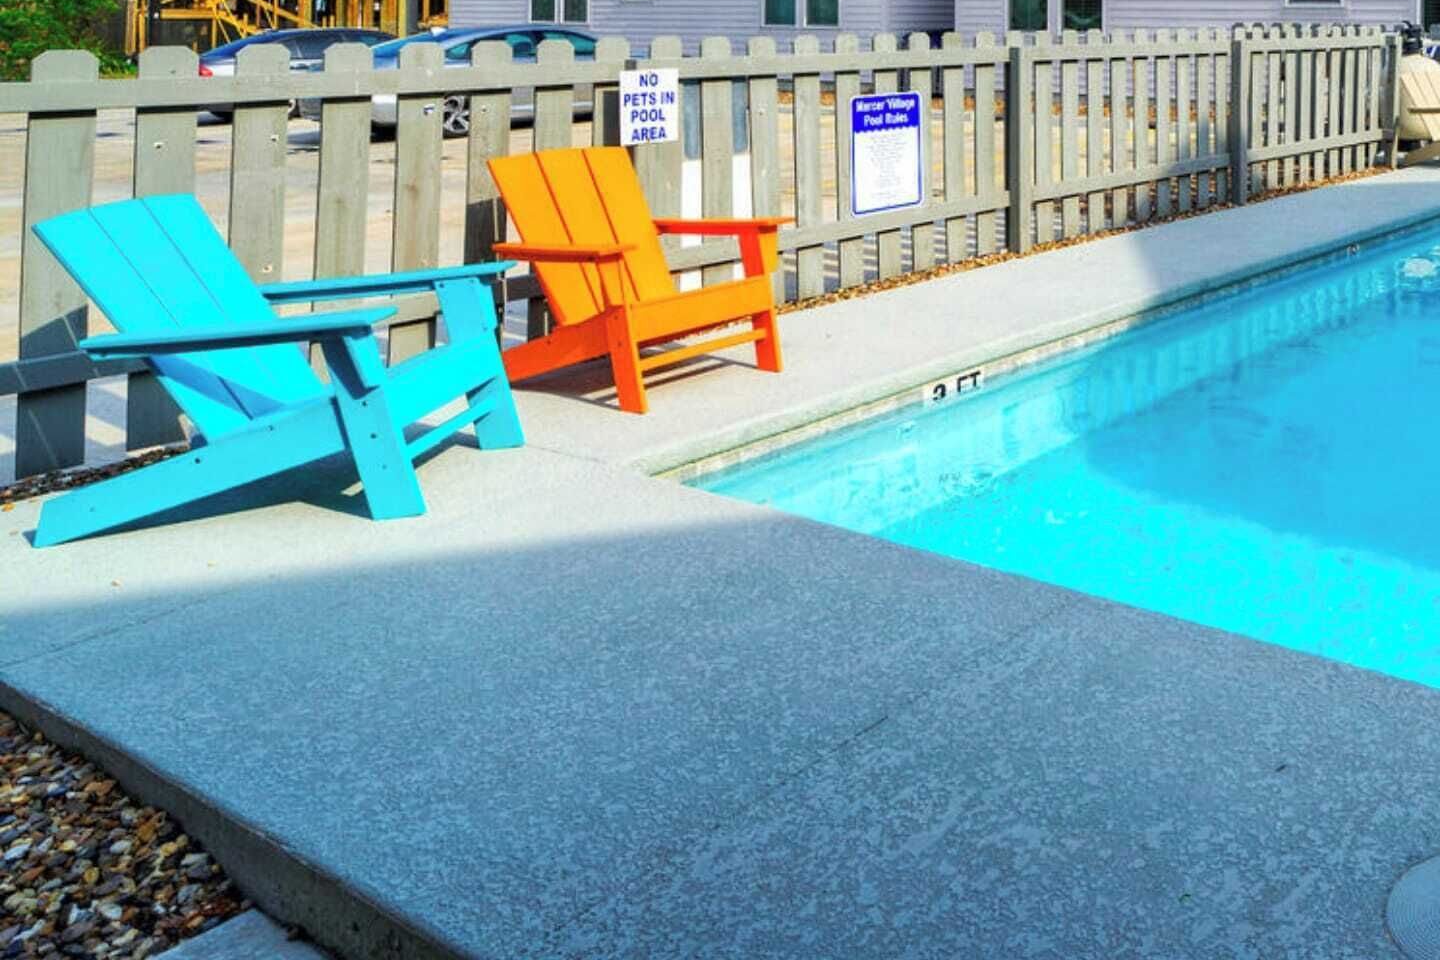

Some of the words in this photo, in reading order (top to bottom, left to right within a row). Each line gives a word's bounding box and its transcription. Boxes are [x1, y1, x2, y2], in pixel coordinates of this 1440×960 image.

[639, 73, 658, 87] NO
[623, 91, 657, 107] PETS
[660, 91, 675, 105] IN
[631, 108, 666, 123] POOL
[863, 114, 884, 127] Pool
[631, 126, 666, 142] AREA
